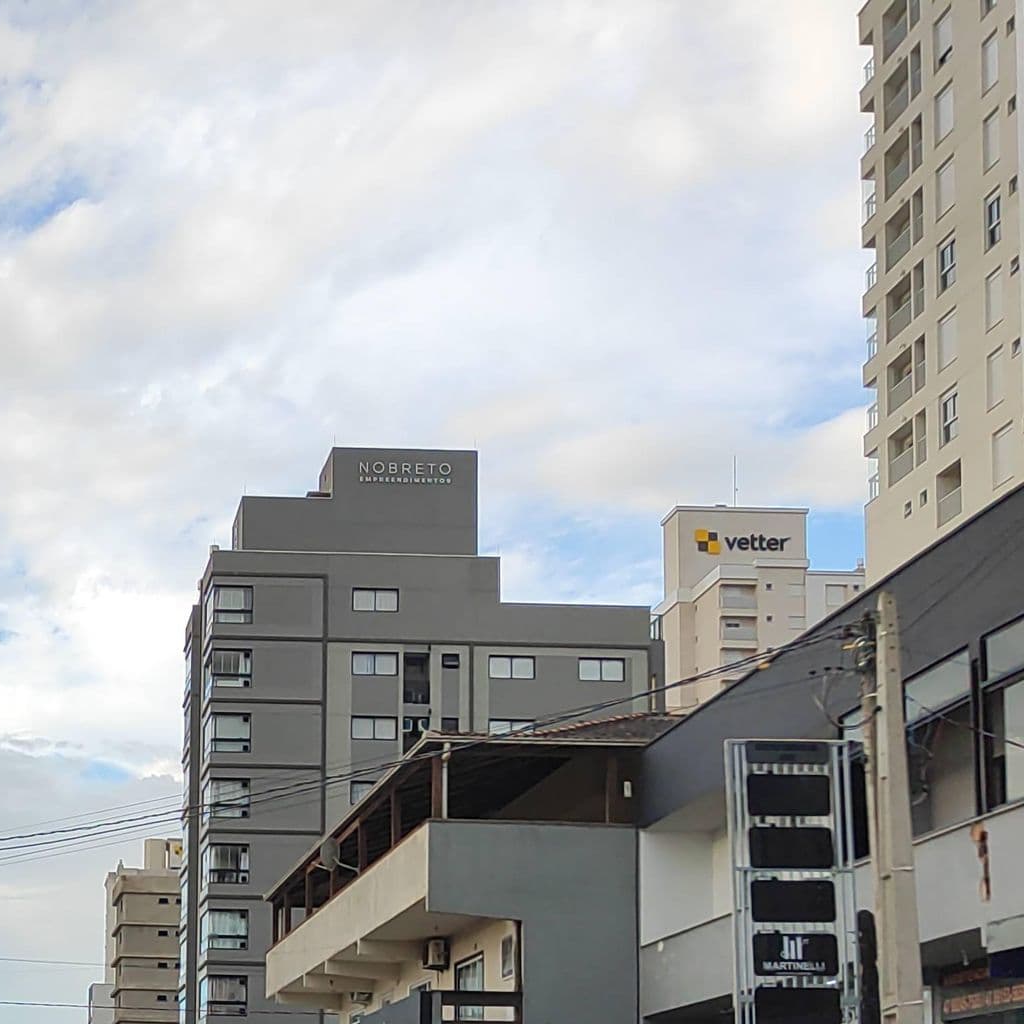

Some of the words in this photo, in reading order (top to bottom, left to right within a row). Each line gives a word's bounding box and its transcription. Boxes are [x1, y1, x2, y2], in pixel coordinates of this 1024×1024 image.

[359, 461, 452, 475] NOBRETO
[359, 476, 451, 484] EMPREENDIMENTOS
[724, 534, 791, 551] vetter
[762, 961, 826, 972] MARTINELLI
